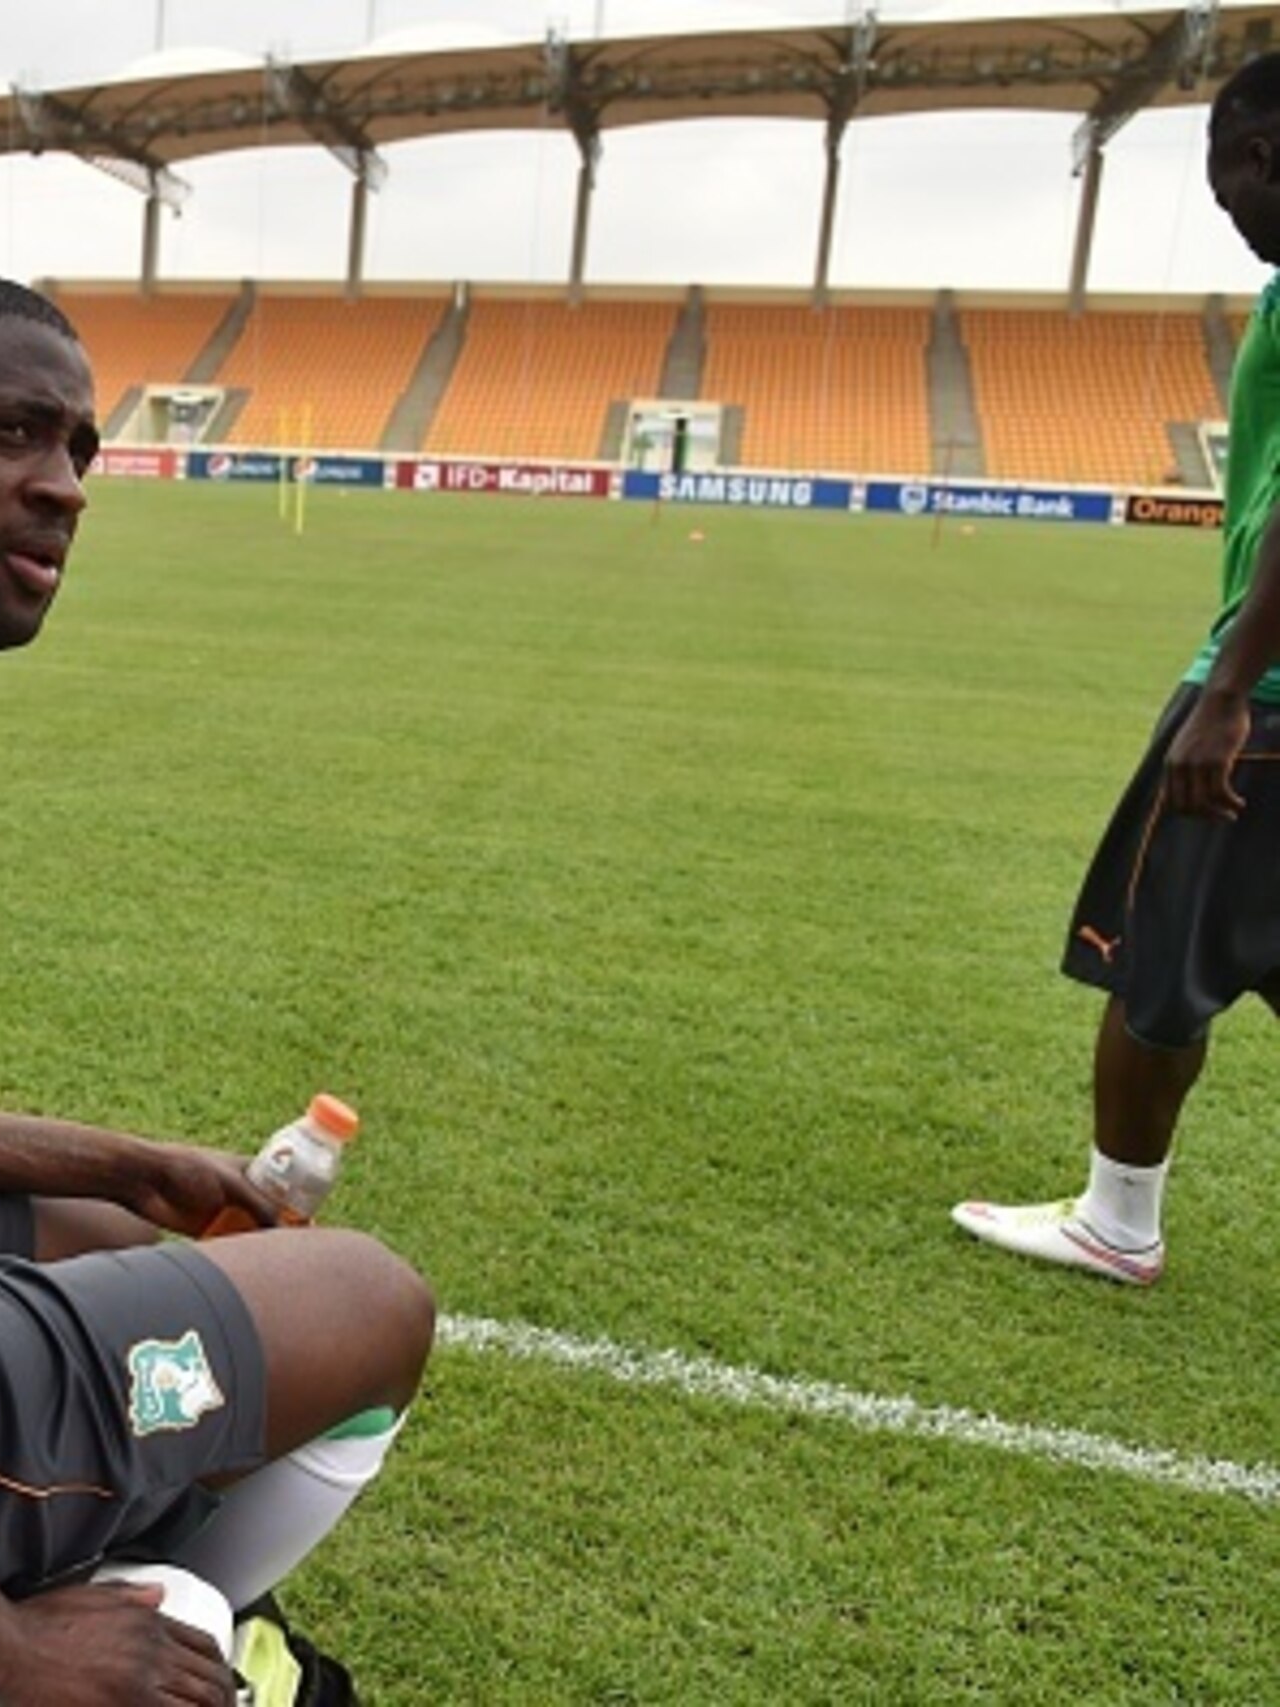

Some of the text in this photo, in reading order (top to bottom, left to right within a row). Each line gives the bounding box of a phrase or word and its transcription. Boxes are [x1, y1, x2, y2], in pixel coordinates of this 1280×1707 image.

[447, 465, 592, 495] IFD-Kapital
[659, 474, 812, 506] SAMSUNG
[933, 491, 1075, 518] Stanbic Bank
